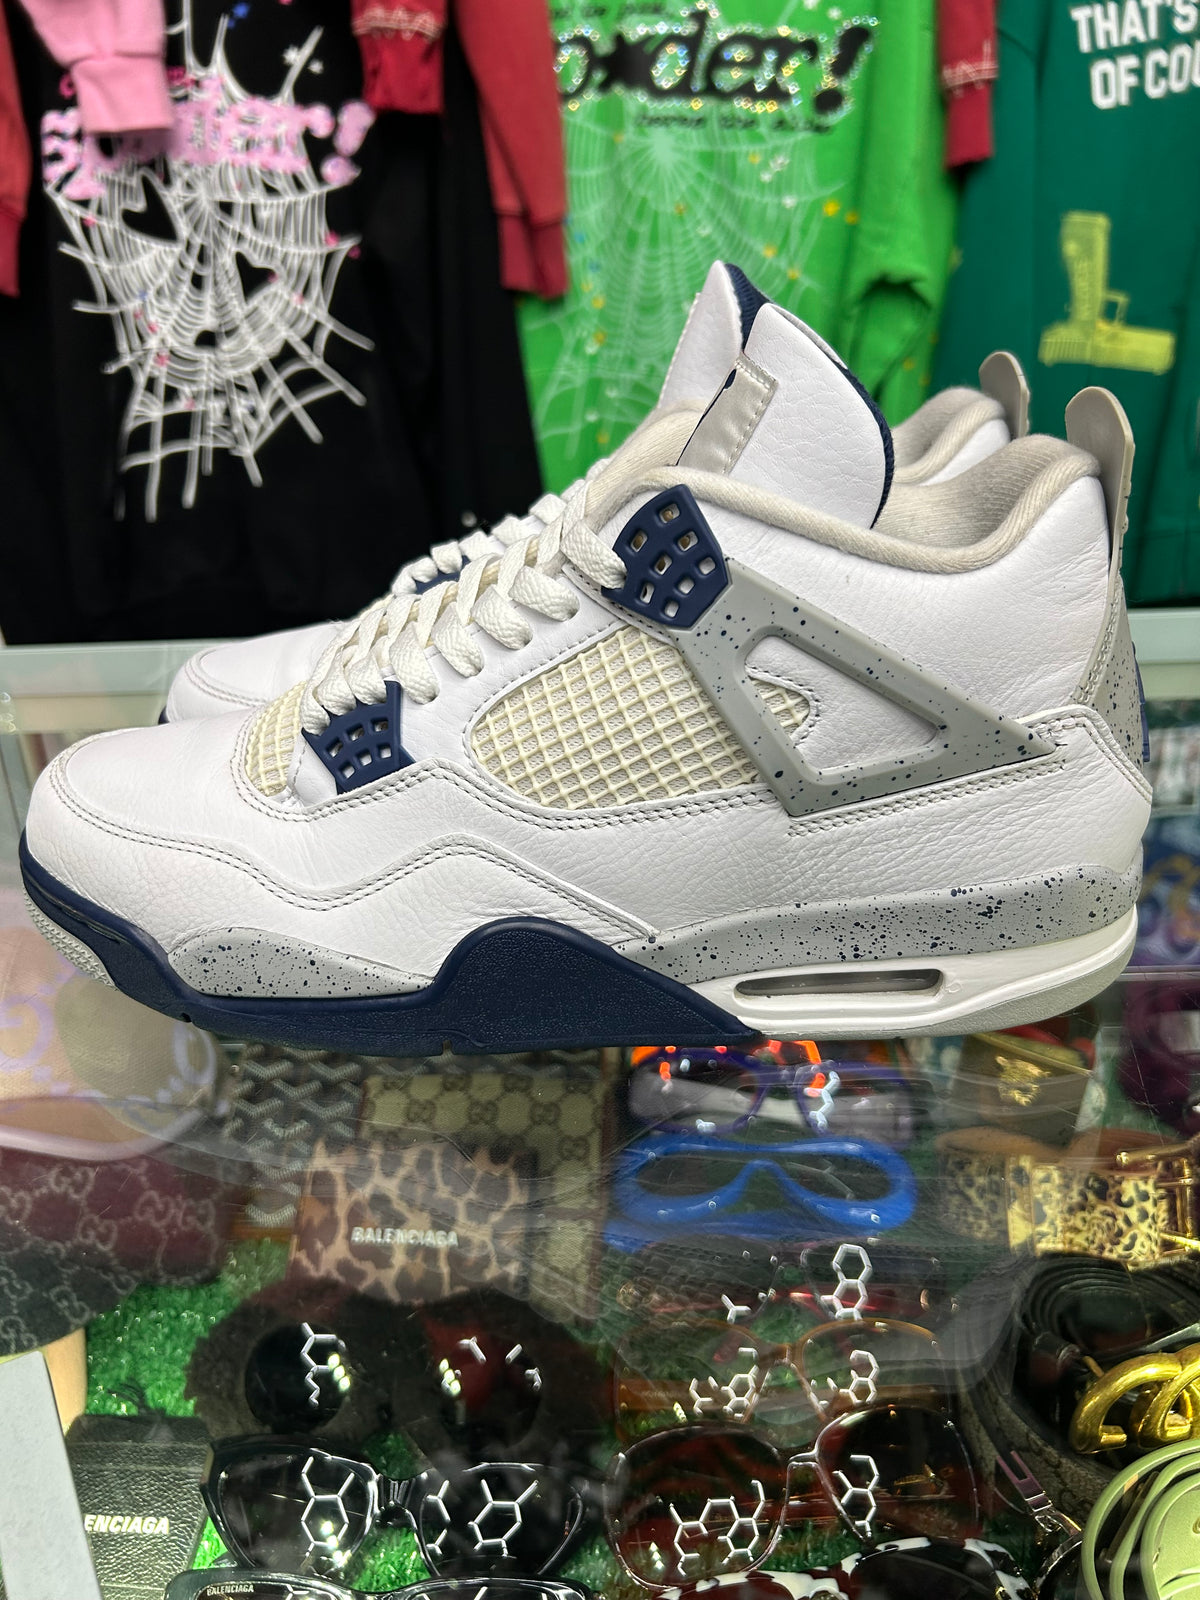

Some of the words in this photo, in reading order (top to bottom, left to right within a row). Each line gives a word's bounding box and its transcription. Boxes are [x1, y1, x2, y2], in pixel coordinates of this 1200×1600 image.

[1090, 54, 1140, 109] OF
[351, 1226, 458, 1248] BALENCIAGA
[206, 1583, 255, 1596] BALENCIAGA
